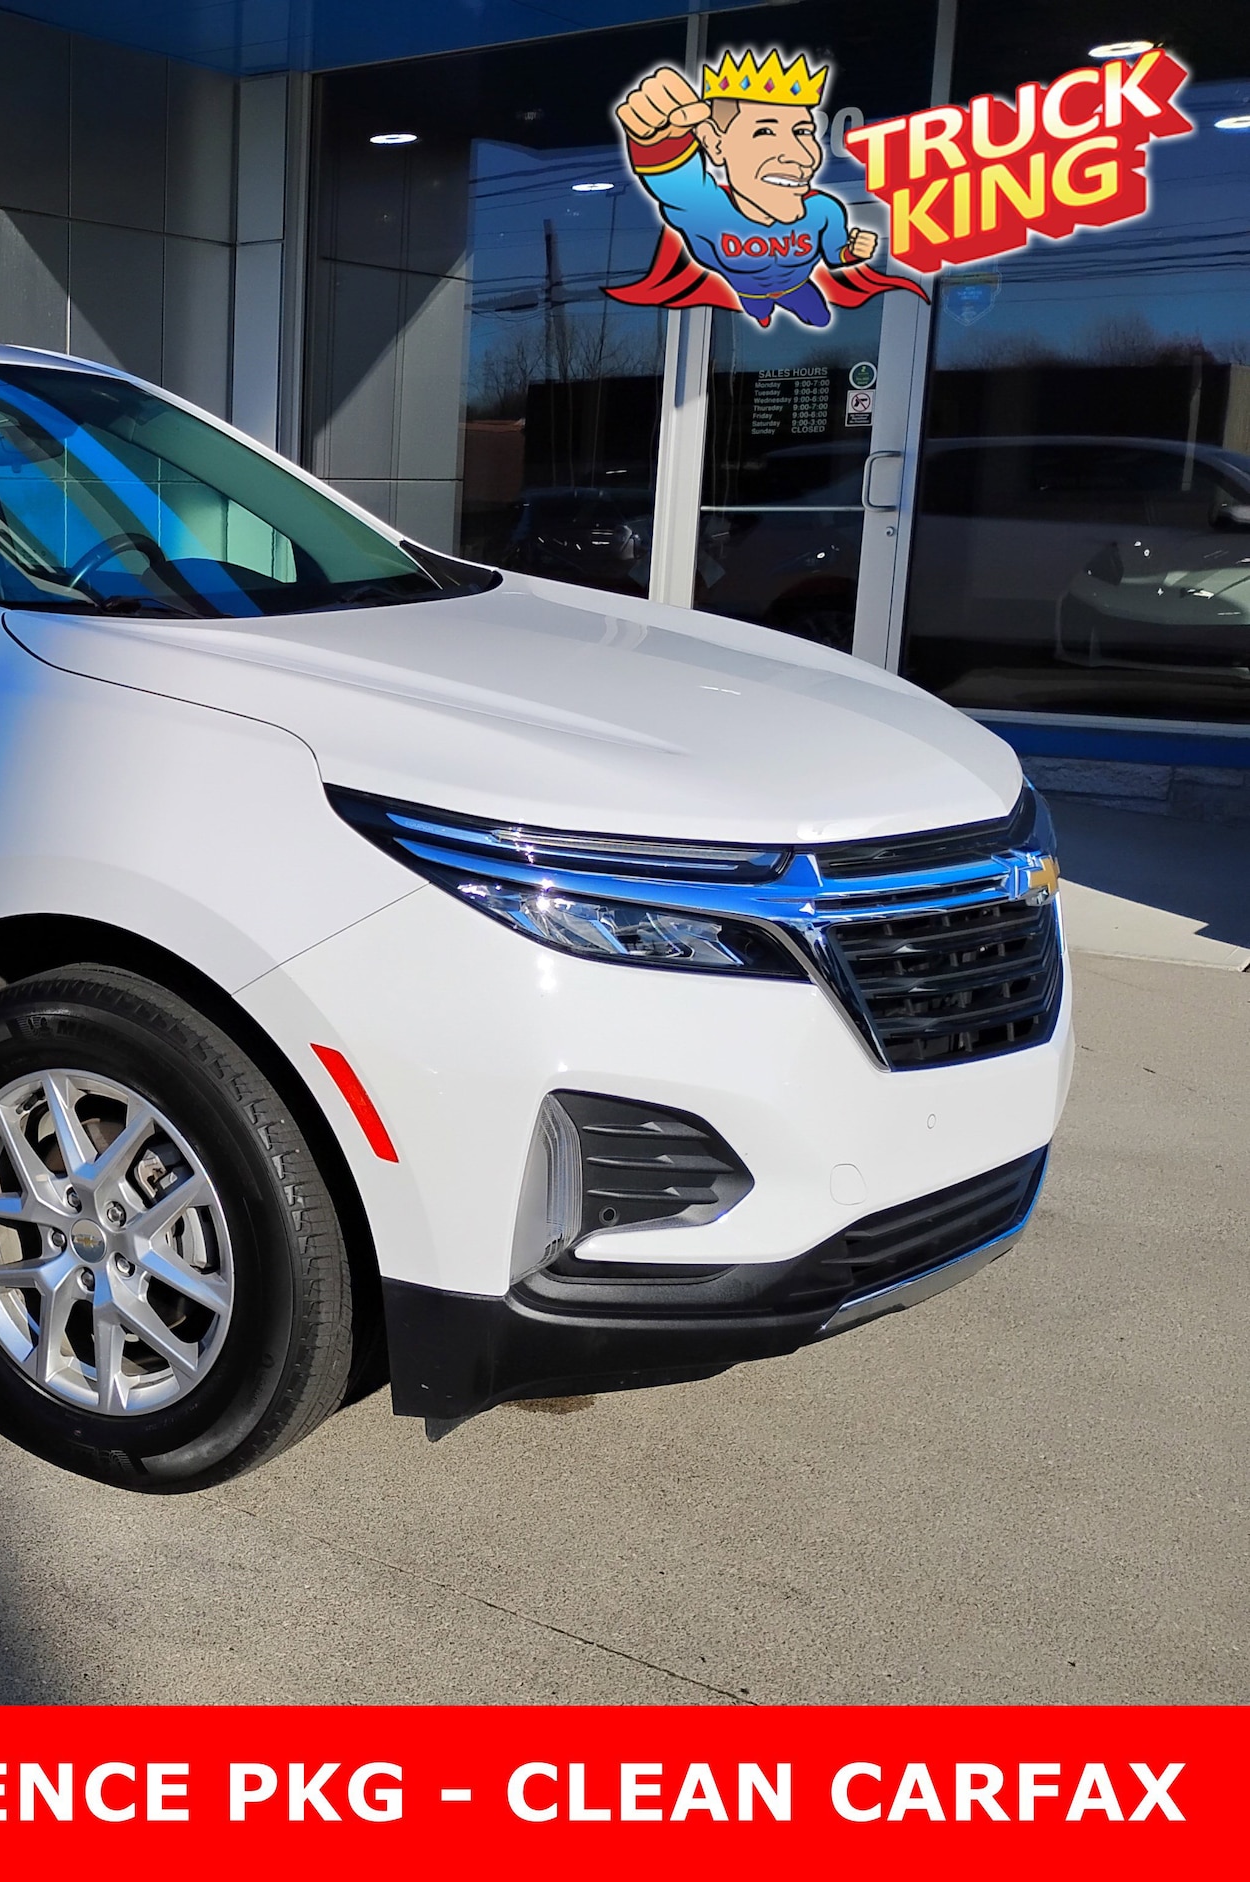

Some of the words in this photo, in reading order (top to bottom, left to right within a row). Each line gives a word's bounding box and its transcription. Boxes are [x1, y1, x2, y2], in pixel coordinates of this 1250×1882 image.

[758, 368, 790, 379] SALES
[792, 366, 828, 377] HOURS
[754, 381, 781, 389] Monday
[754, 389, 780, 397] Tuesday
[753, 396, 792, 404] Wednesday
[752, 412, 773, 420] Friday
[791, 426, 826, 434] CLOSED
